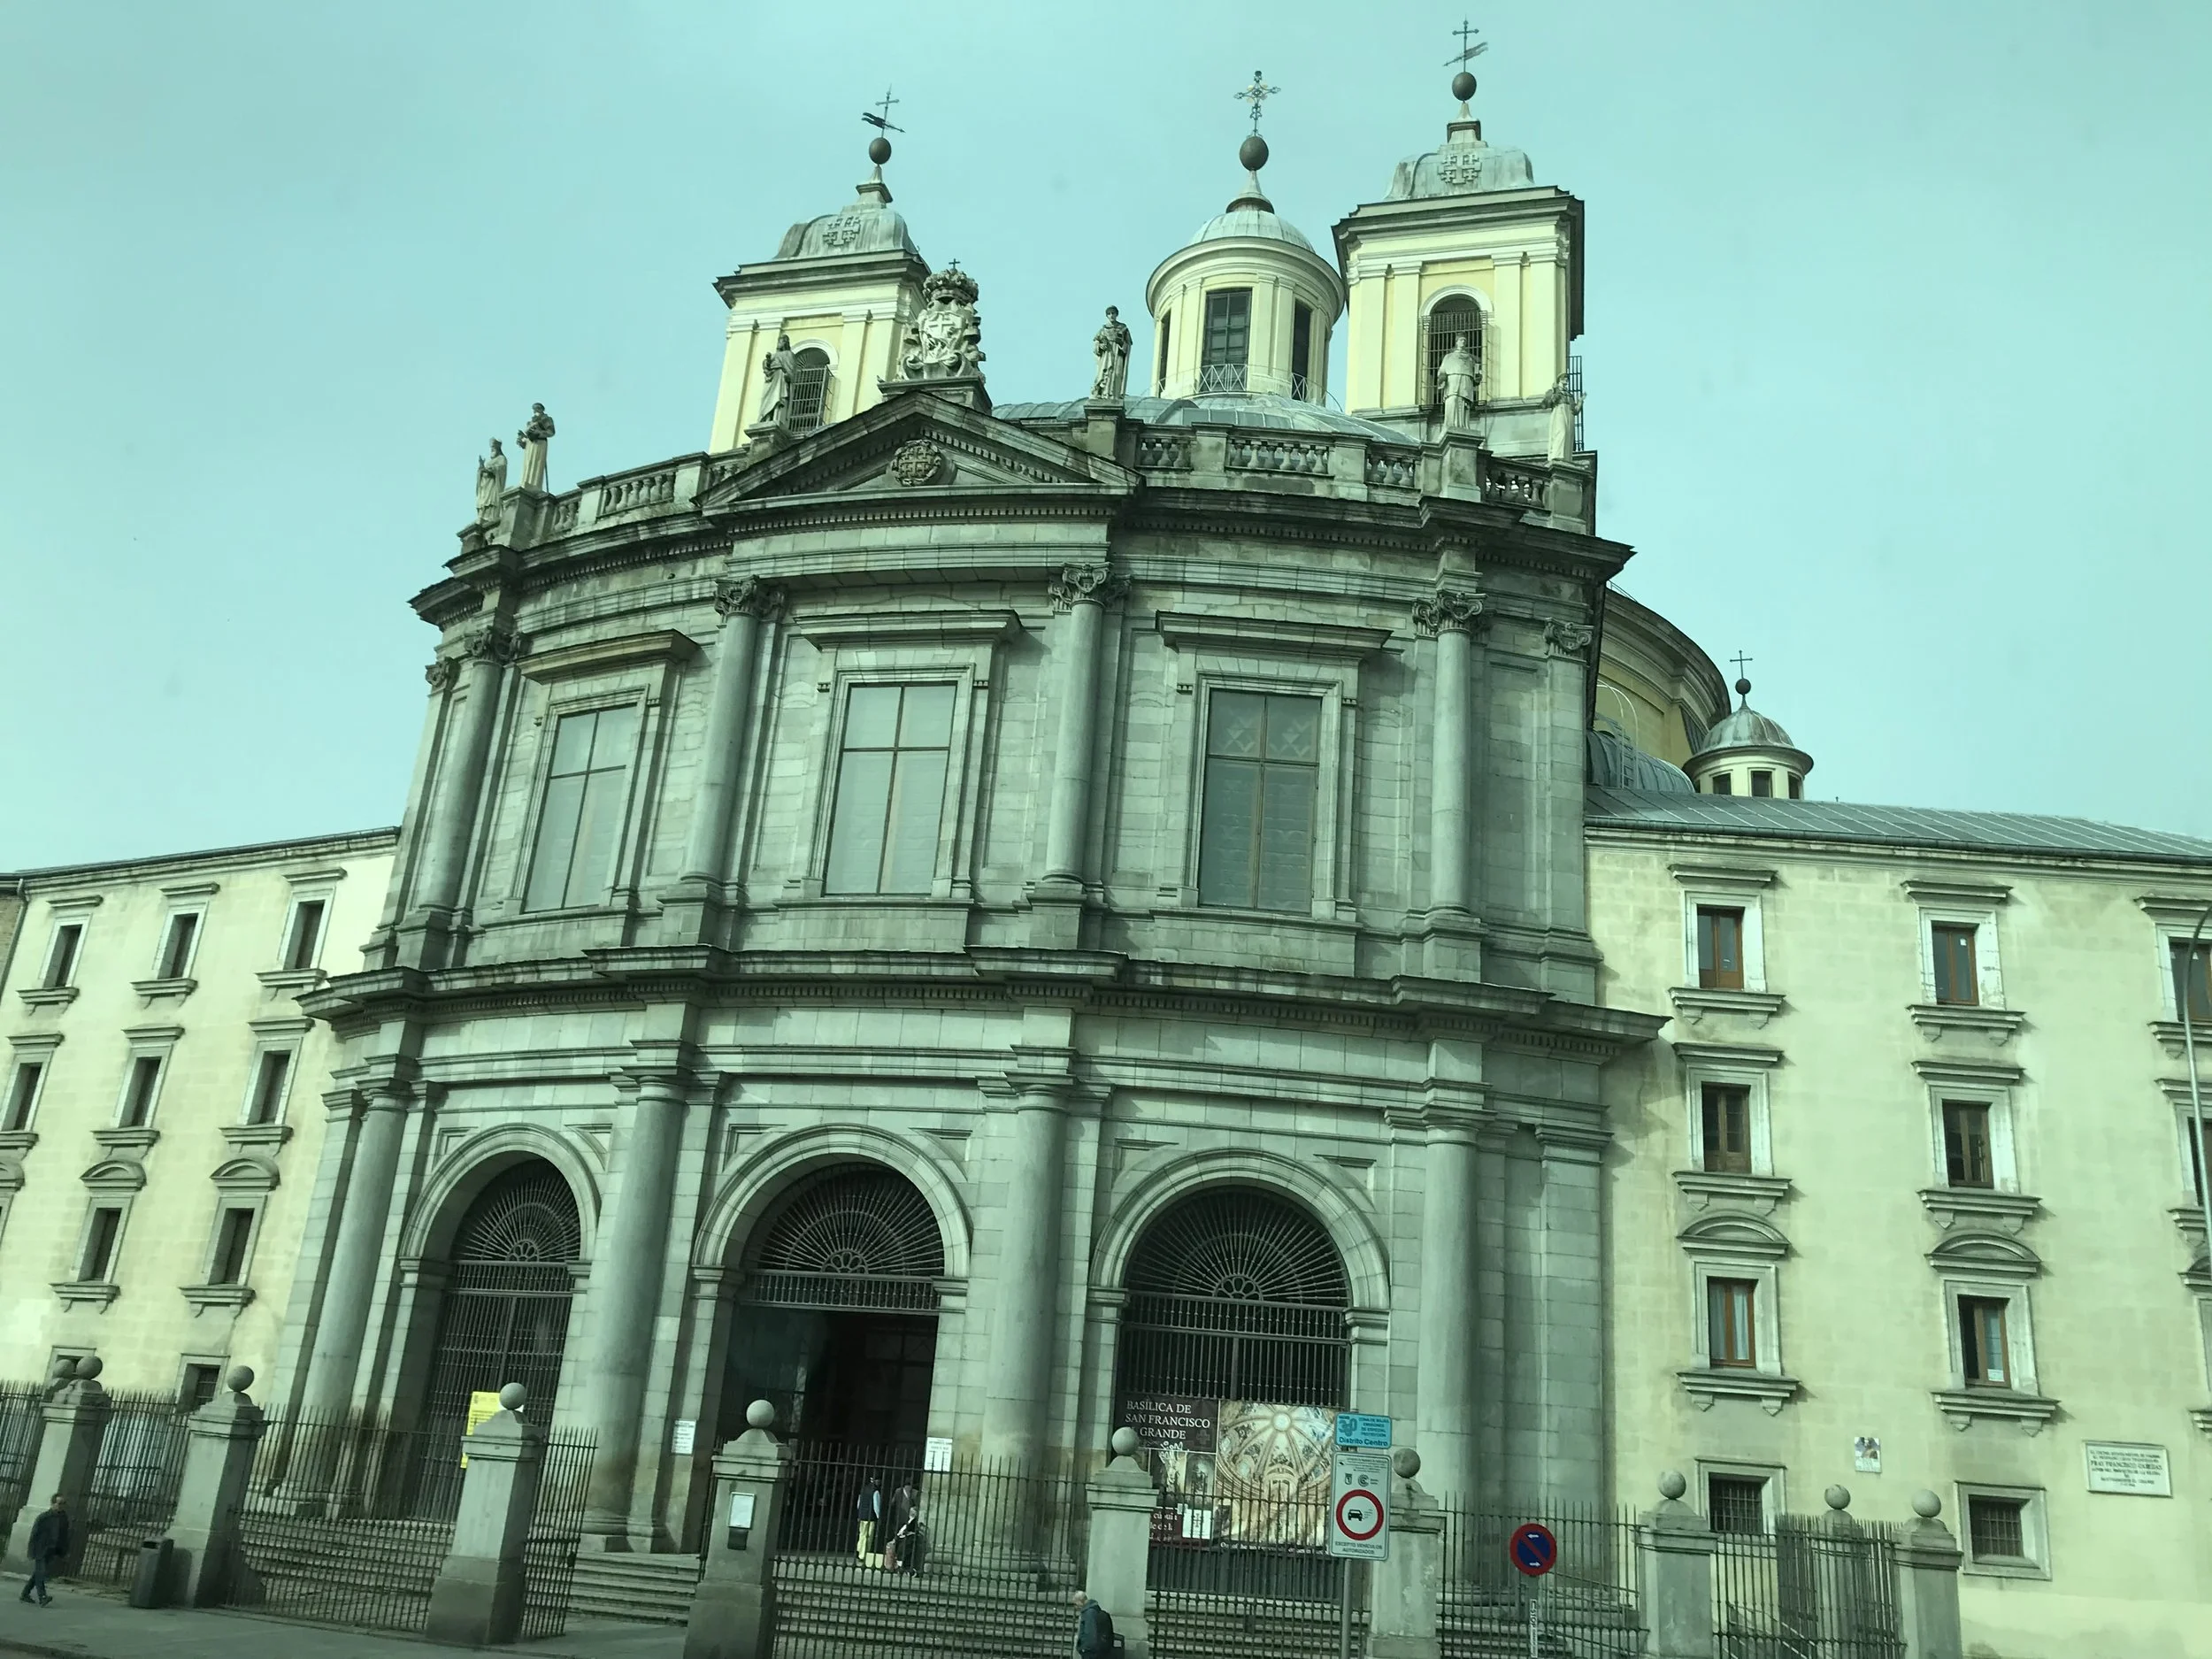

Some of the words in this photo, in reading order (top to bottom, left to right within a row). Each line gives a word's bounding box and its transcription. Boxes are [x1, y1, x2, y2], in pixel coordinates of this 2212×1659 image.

[1126, 1399, 1174, 1413] BASÍLICA
[1176, 1403, 1192, 1414] DE
[1125, 1413, 1147, 1424] SAN
[1148, 1414, 1210, 1429] FRANCISCO
[1140, 1426, 1187, 1440] GRANDE
